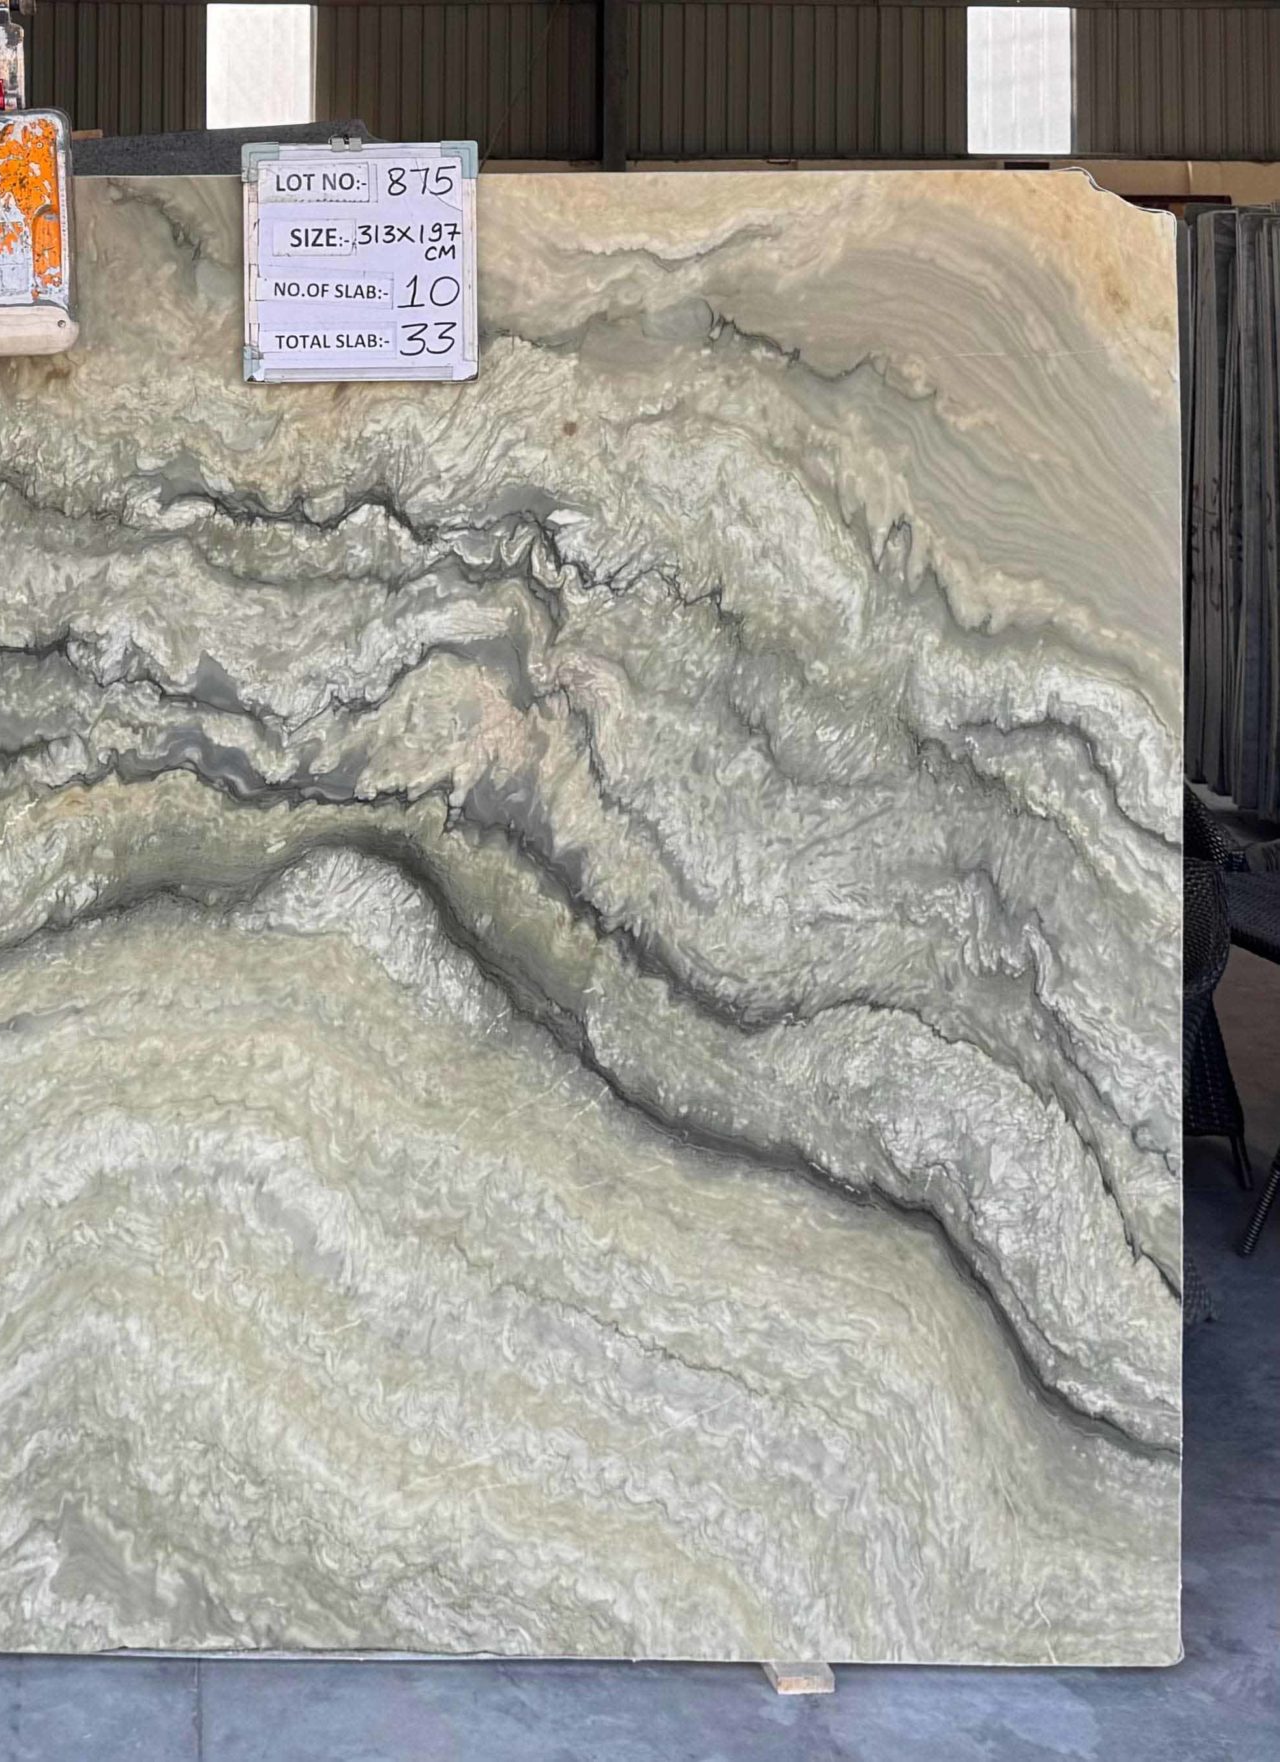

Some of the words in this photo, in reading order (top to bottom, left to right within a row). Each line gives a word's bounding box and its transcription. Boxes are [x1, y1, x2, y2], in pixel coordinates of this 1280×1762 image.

[276, 174, 315, 192] LOT
[387, 166, 457, 196] 875
[424, 245, 456, 261] CM
[274, 282, 329, 298] NO.OF
[397, 275, 460, 308] 10
[275, 334, 331, 350] TOTAL
[400, 322, 457, 356] 33
